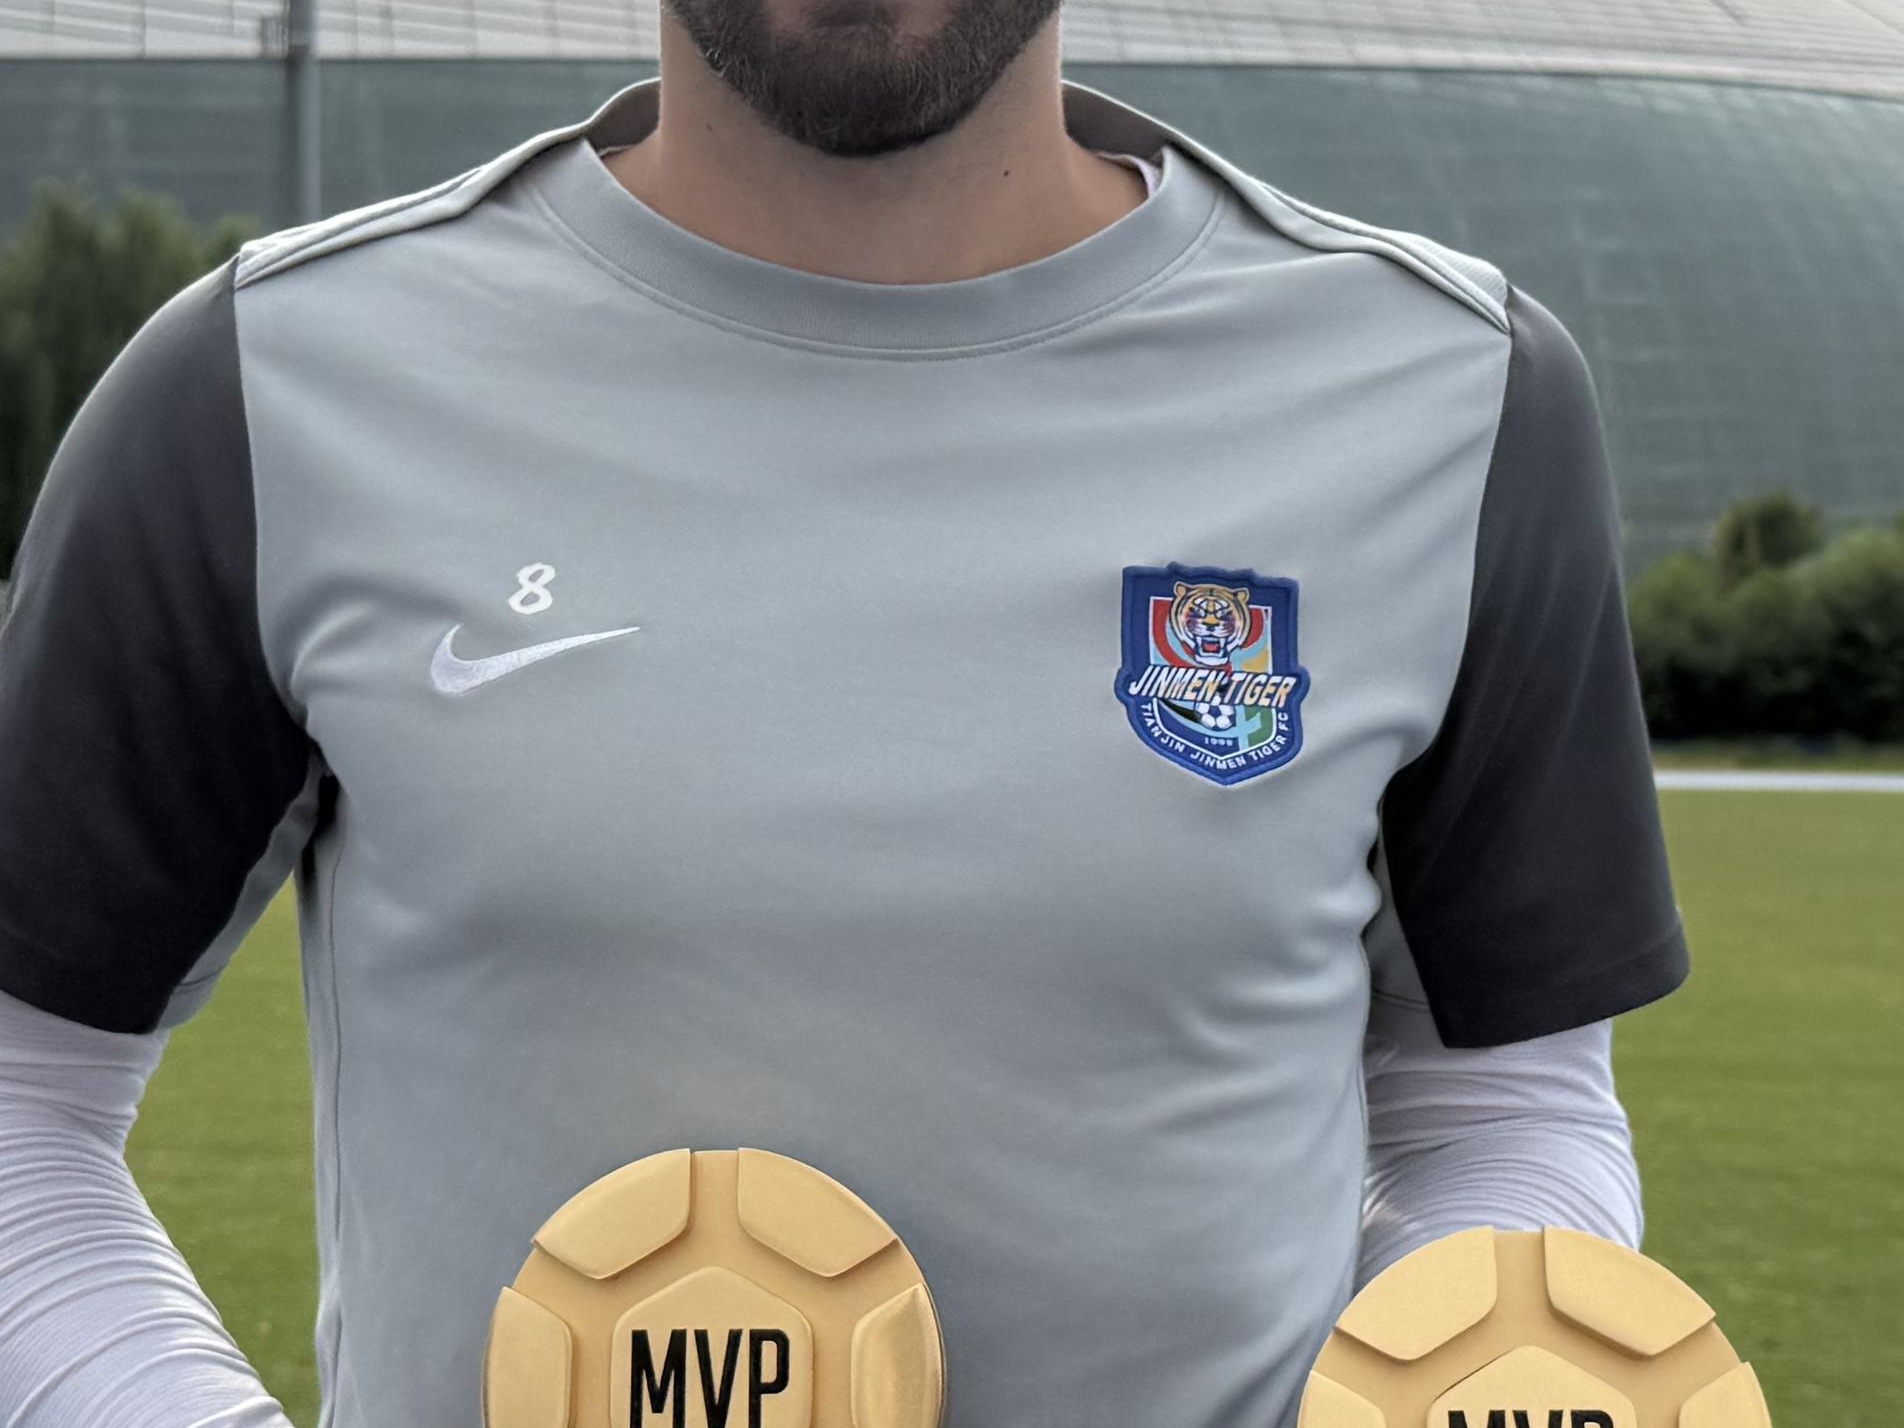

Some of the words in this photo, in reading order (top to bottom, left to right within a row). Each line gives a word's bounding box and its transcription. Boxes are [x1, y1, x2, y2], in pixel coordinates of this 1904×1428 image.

[508, 562, 556, 615] 8
[1128, 665, 1225, 702] JINMEN
[1224, 673, 1297, 708] TIGER
[1141, 702, 1186, 753] TIANJIN
[1190, 752, 1247, 770] JINMEN
[1248, 735, 1288, 762] TIGER
[1278, 712, 1289, 732] FC
